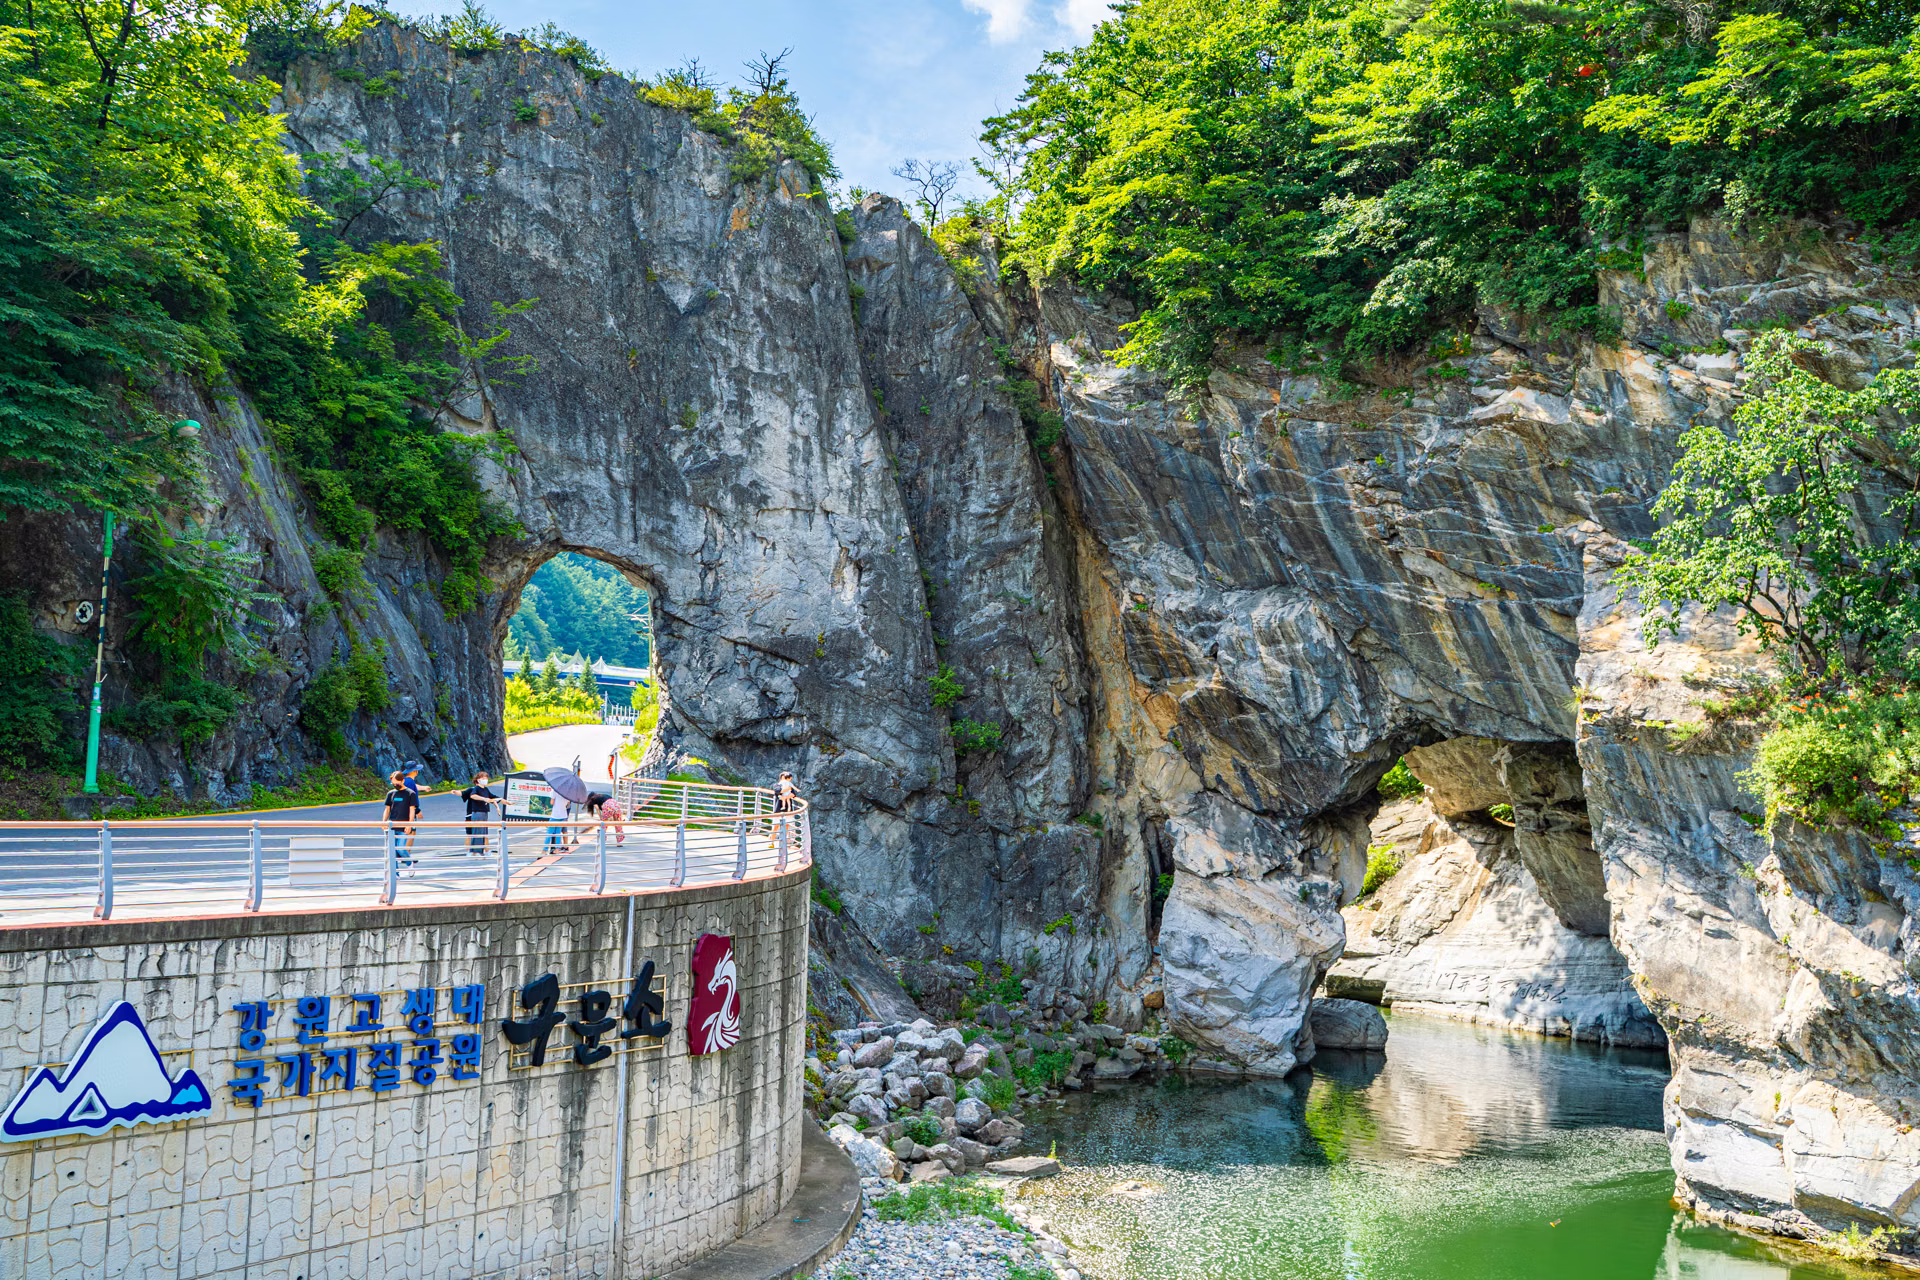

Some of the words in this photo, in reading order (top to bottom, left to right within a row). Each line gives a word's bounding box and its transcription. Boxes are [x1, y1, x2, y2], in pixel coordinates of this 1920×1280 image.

[232, 983, 485, 1051] 강원고생대
[502, 960, 672, 1066] 구문소
[227, 1034, 482, 1108] 국가지질공원
